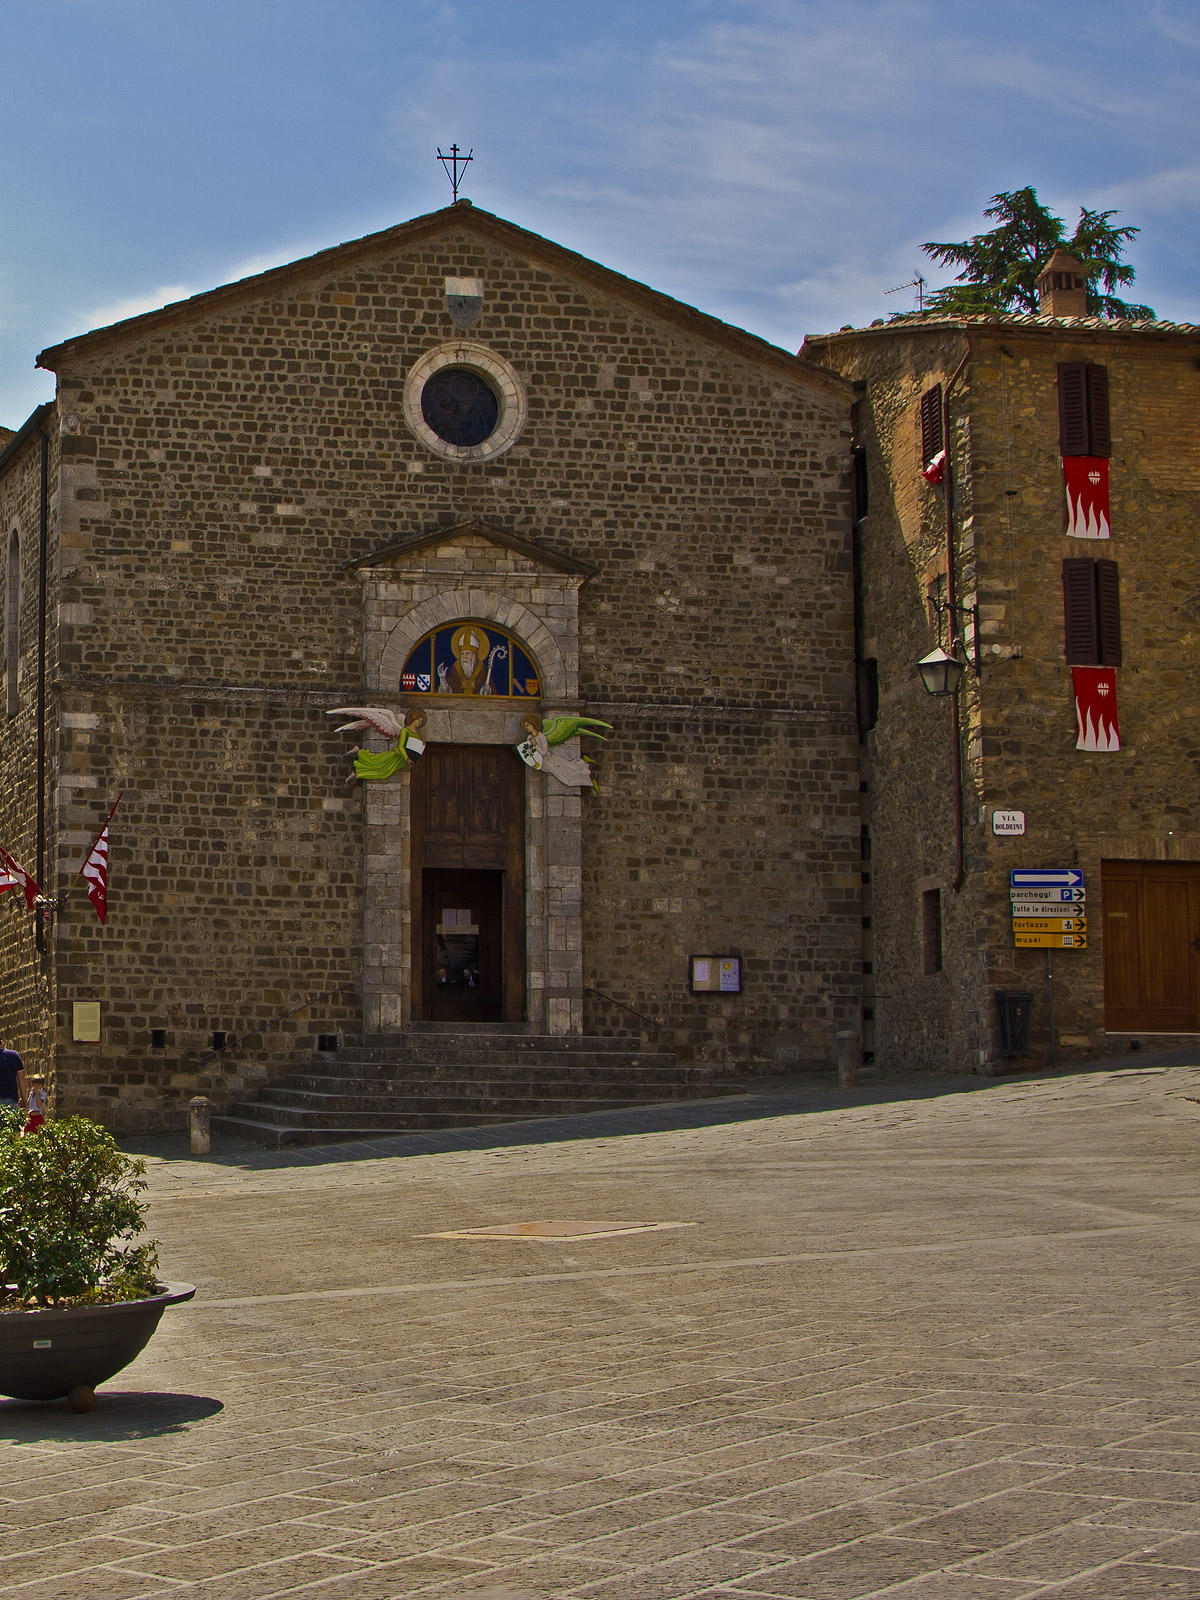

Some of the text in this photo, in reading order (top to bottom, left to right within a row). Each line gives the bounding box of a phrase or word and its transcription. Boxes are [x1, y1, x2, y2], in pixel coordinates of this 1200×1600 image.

[1011, 890, 1070, 899] parcheggi P
[1013, 905, 1070, 913] tutte le direzioni
